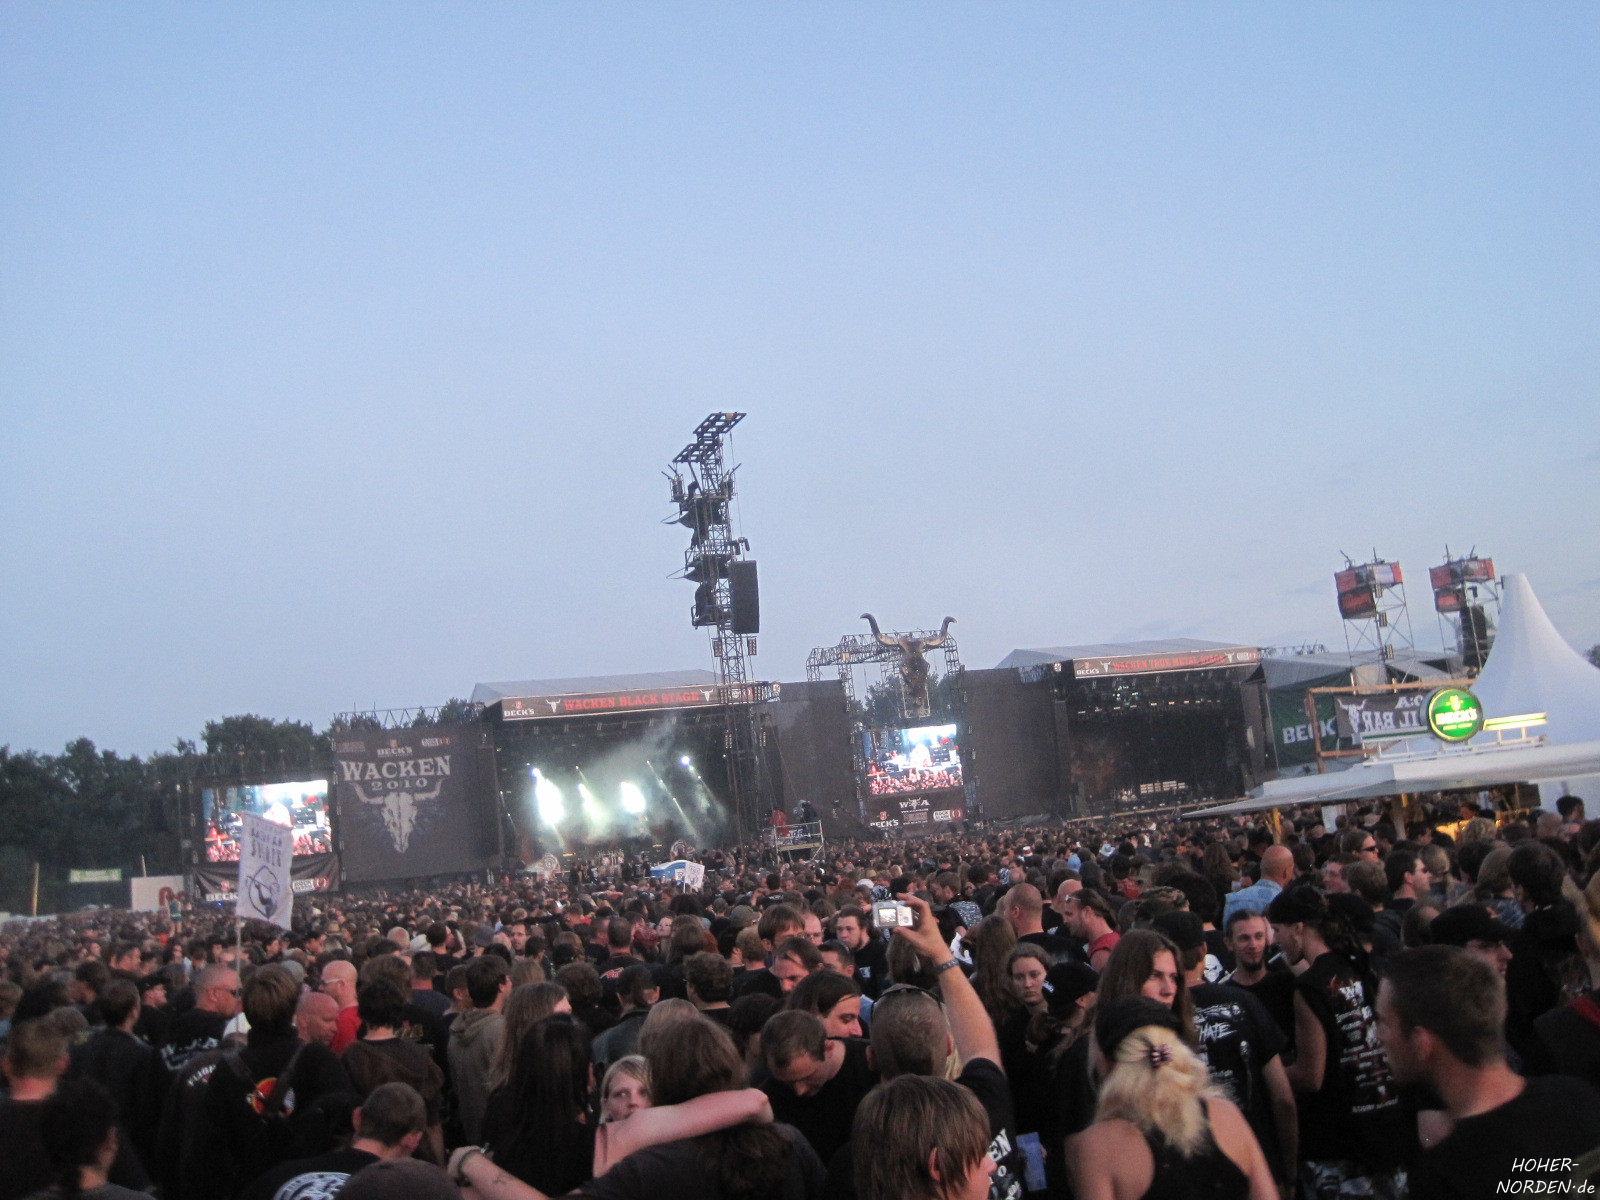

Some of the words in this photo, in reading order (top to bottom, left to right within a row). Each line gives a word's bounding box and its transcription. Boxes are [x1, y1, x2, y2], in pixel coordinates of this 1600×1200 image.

[564, 697, 616, 711] WACKEN
[619, 693, 659, 707] BLACK
[661, 690, 700, 704] STAGE
[339, 755, 451, 782] WACKEN
[371, 777, 428, 792] 2010
